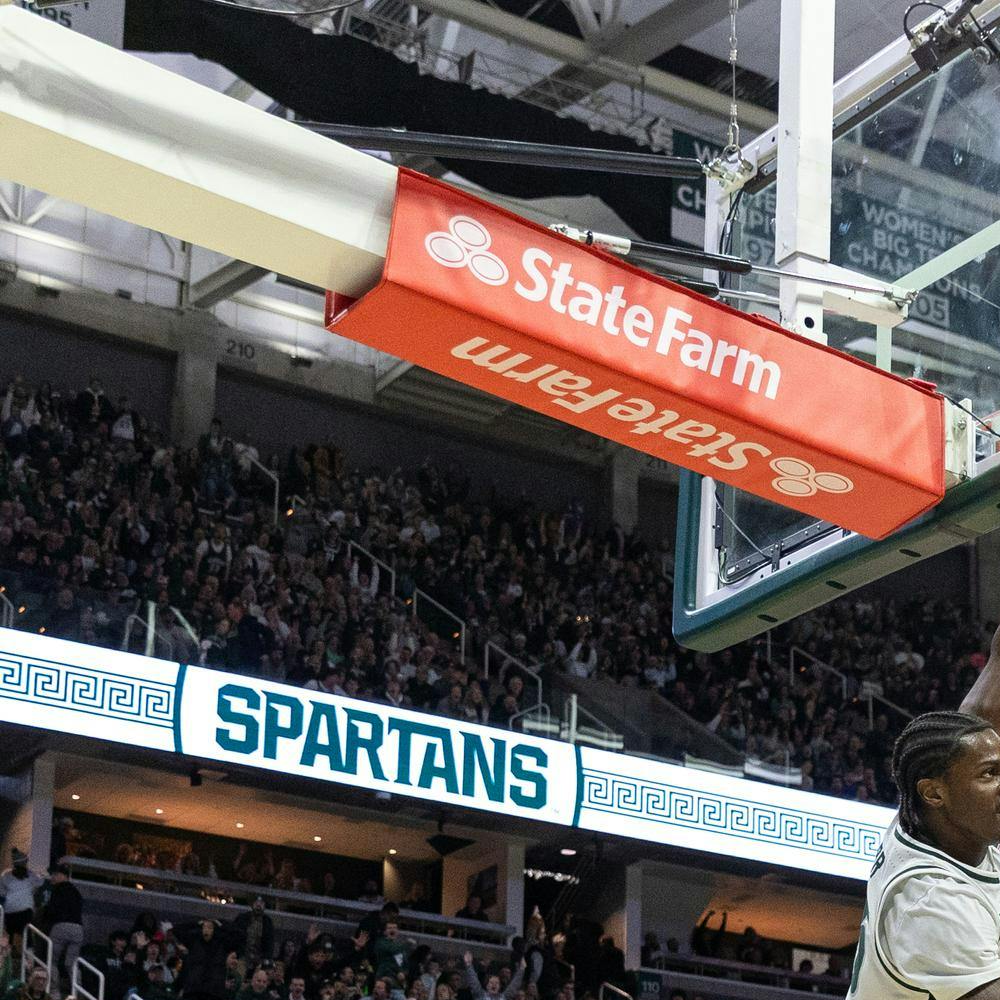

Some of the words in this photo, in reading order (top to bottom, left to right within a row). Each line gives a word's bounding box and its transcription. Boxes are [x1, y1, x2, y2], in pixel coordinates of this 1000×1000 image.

[872, 228, 909, 257] BIG
[226, 340, 255, 359] 210
[215, 683, 548, 810] SPARTANS
